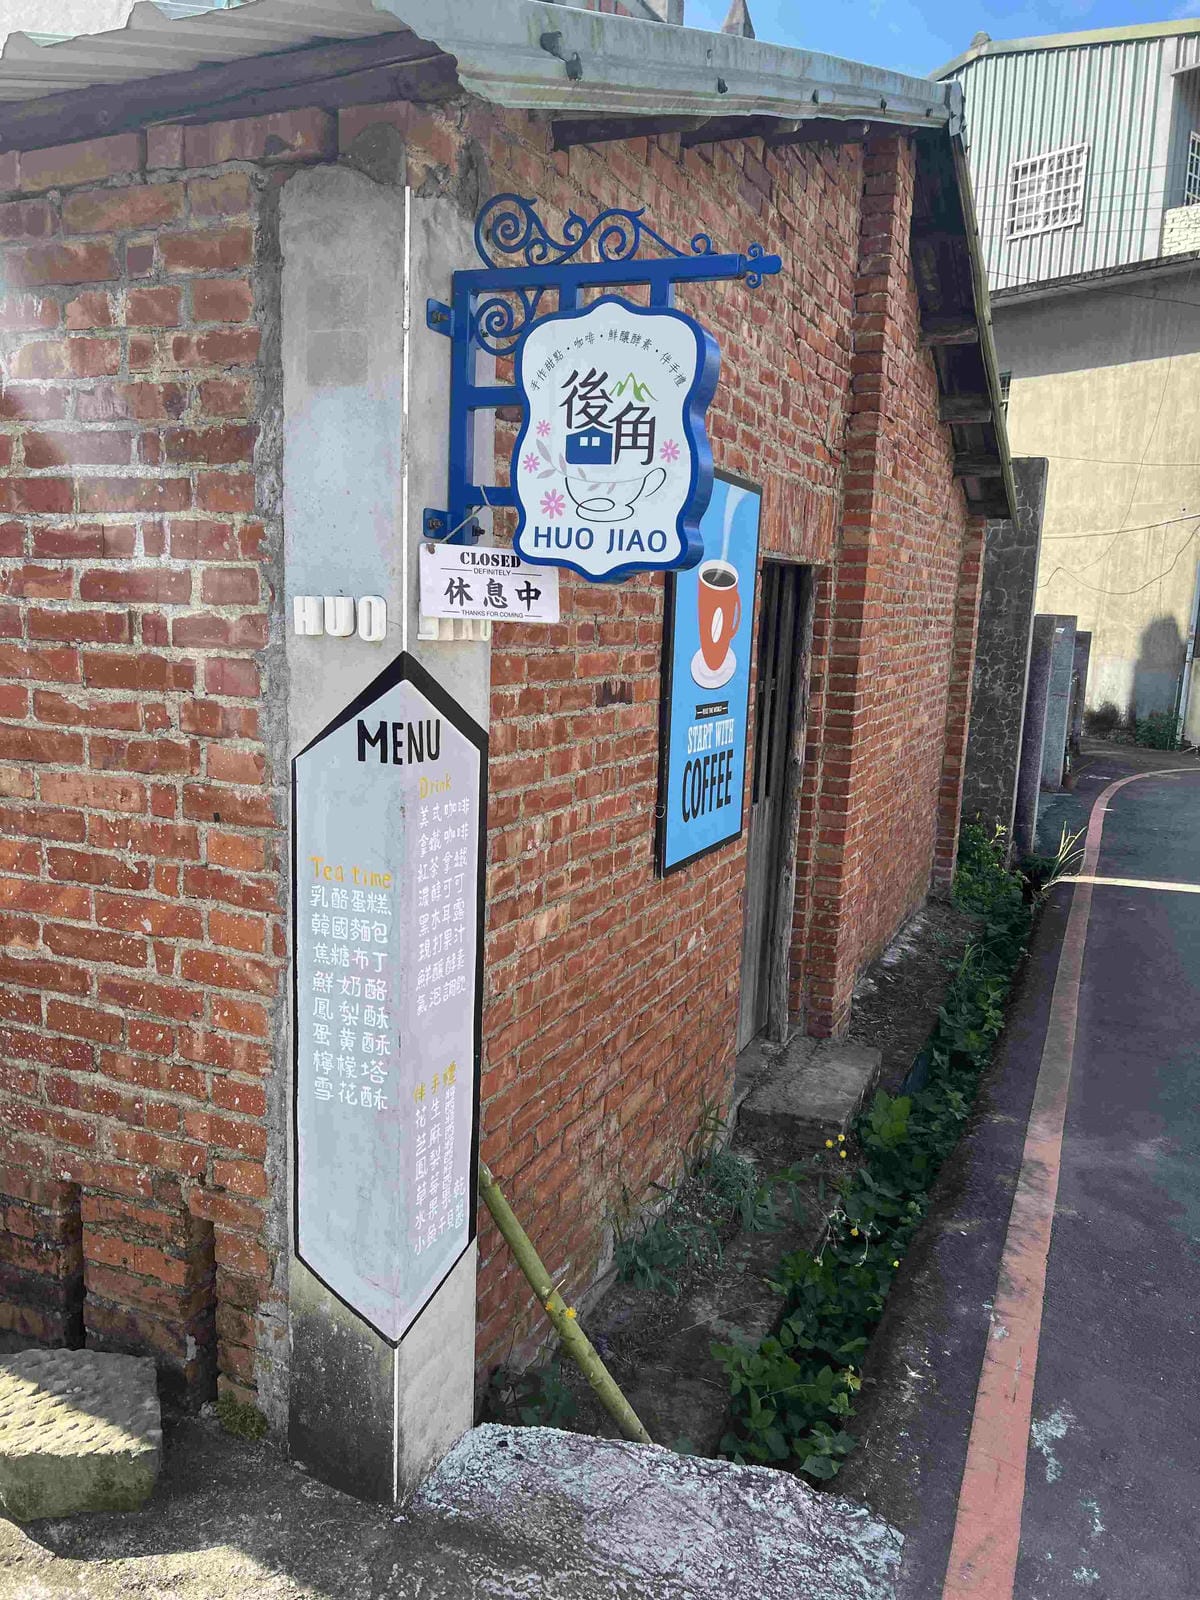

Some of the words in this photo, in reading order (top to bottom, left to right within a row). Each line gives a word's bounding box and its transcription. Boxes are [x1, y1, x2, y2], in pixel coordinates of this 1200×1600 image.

[573, 331, 596, 349] 咖啡
[558, 367, 656, 466] 後角
[534, 526, 594, 550] HUO
[606, 528, 667, 554] JIAO
[460, 551, 521, 568] CLOSED
[473, 567, 512, 576] DEFINITELY
[443, 577, 542, 612] 休息中
[293, 595, 387, 642] HUO
[461, 609, 486, 617] THANKS
[499, 611, 524, 619] COMING
[356, 719, 441, 766] MENU
[687, 722, 713, 755] START
[715, 718, 735, 748] WITH
[419, 773, 452, 800] Drink
[682, 749, 734, 823] COFFEE
[418, 795, 470, 829] 美式咖啡
[308, 855, 344, 882] Tea
[350, 865, 393, 889] time
[309, 884, 393, 916] 乳酪蛋糕
[310, 912, 389, 944] 韓國麵包
[312, 942, 389, 974] 焦糖布丁
[311, 971, 388, 1002] 鮮奶酪
[312, 997, 389, 1029] 鳳梨酥
[312, 1022, 391, 1056] 蛋黃酥
[312, 1050, 388, 1084] 檸檬塔
[313, 1076, 389, 1111] 雪花酥
